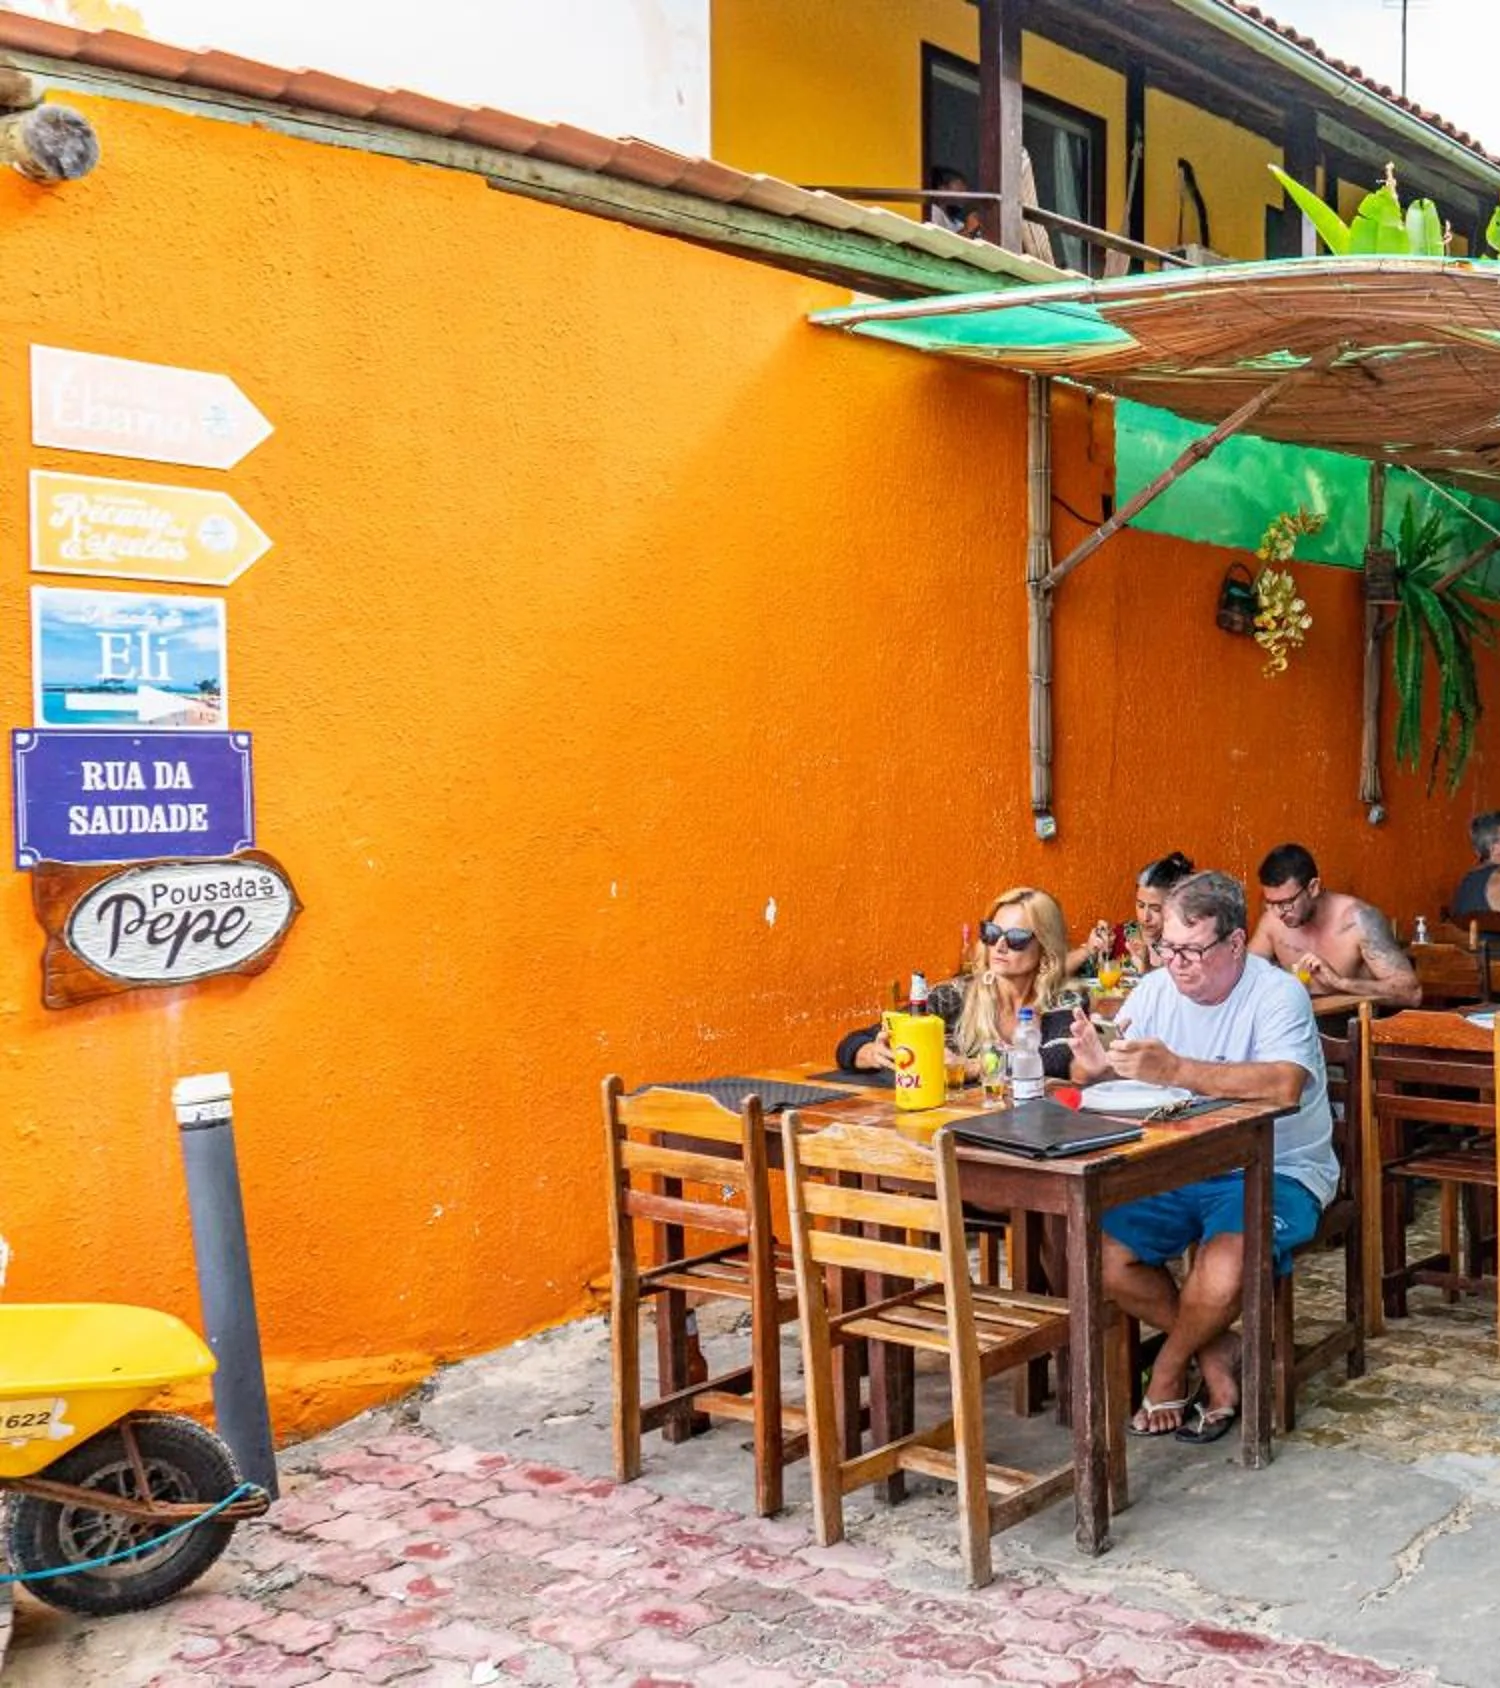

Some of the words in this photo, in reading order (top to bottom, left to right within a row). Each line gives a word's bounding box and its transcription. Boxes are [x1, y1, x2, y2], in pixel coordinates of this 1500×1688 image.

[96, 631, 173, 681] Eli
[81, 761, 147, 791] RUA
[152, 761, 194, 790] DA
[69, 803, 209, 835] SAUDADE
[151, 876, 257, 907] Pousada
[96, 892, 253, 970] Pepe
[0, 1411, 52, 1430] 622
